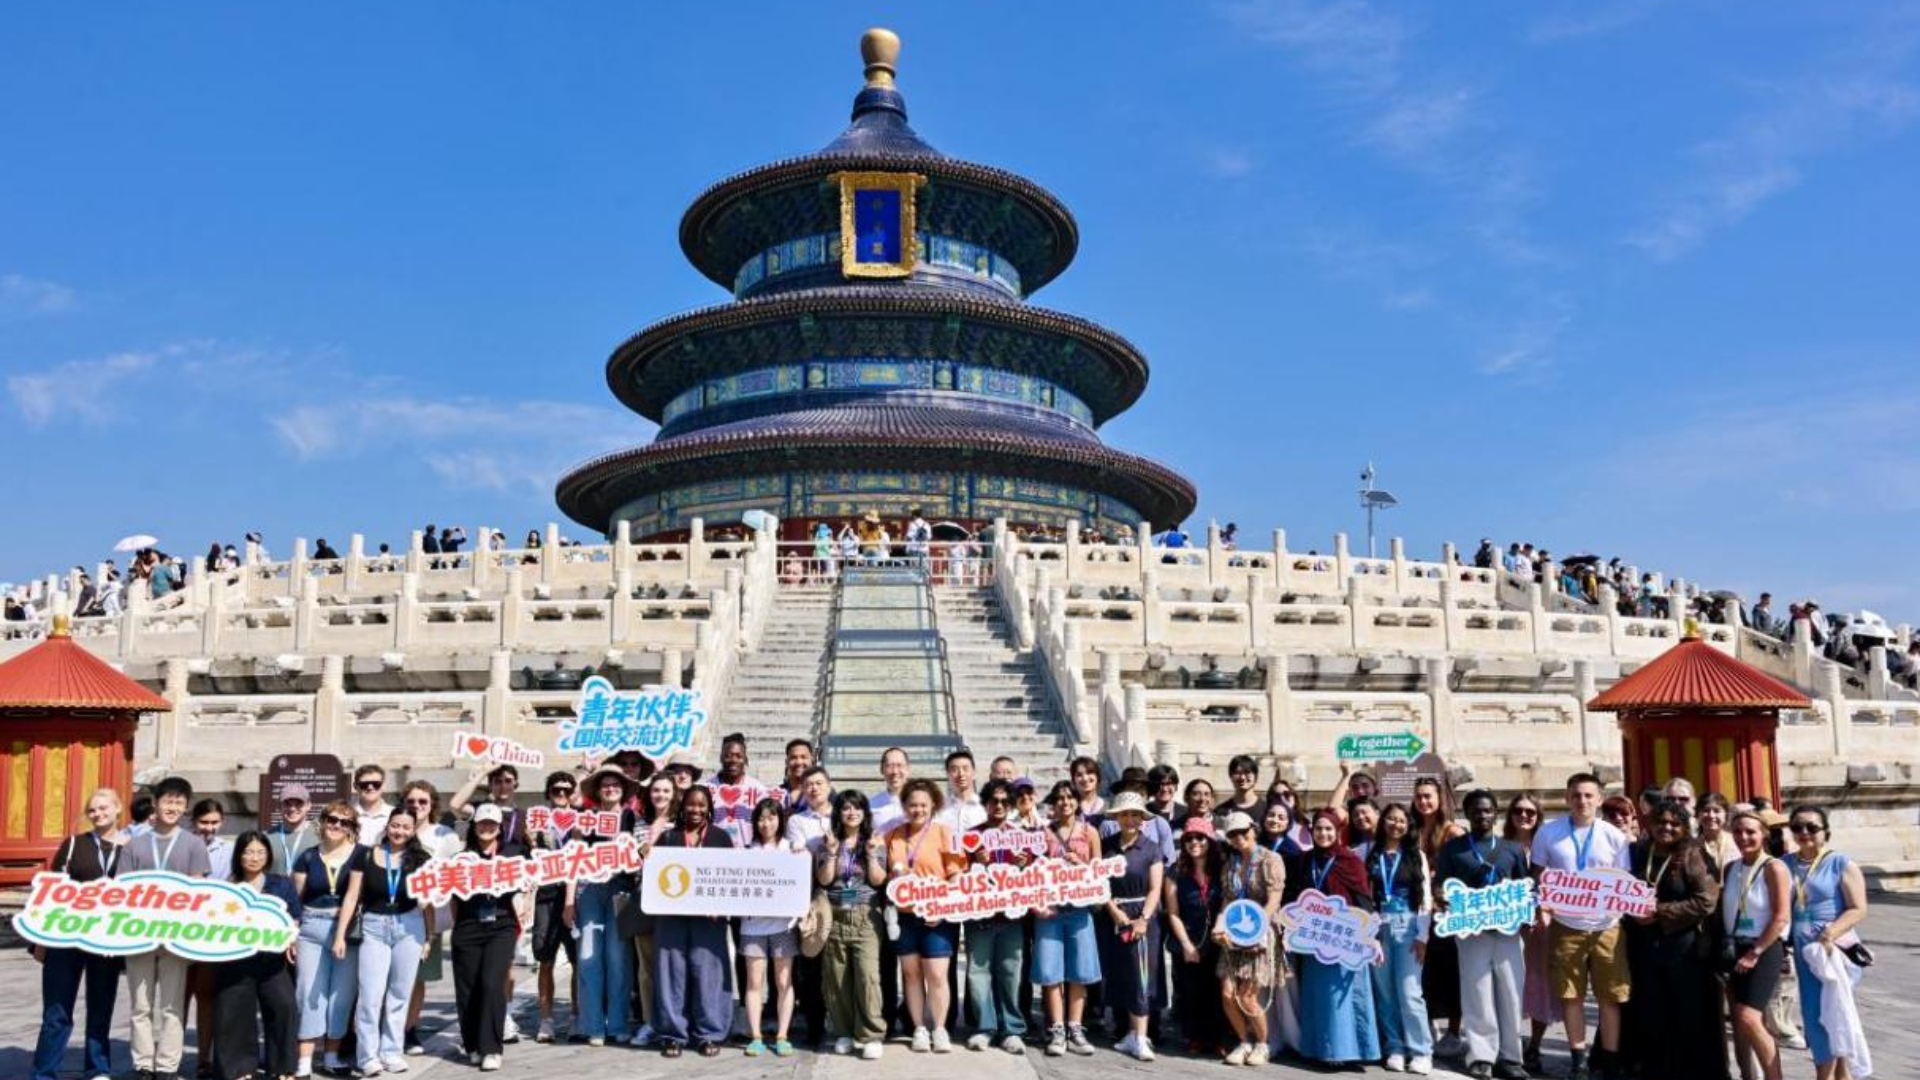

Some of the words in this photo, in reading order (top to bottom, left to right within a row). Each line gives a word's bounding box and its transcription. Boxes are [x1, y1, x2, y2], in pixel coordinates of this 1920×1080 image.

[582, 692, 692, 725] 青年伙伴
[456, 734, 463, 755] I
[490, 740, 541, 764] China
[573, 719, 693, 752] 国际交流计划
[1352, 736, 1411, 751] Together
[529, 809, 549, 829] 我
[578, 812, 619, 834] 中国
[984, 830, 1044, 850] Beijing
[410, 859, 522, 897] 中美青年
[541, 841, 642, 881] 亚太同心
[696, 867, 711, 876] NG
[716, 867, 743, 877] TENG
[746, 868, 775, 877] FONG
[993, 867, 1045, 891] Youth
[1092, 860, 1111, 876] for
[1114, 862, 1122, 874] a
[32, 877, 211, 912] Together
[926, 899, 973, 917] Shared
[976, 889, 1058, 909] Asia-Pacific
[1059, 884, 1104, 900] Future
[1305, 902, 1333, 916] 2026
[1448, 883, 1526, 914] 青年伙伴
[1541, 886, 1597, 908] Youth
[1604, 895, 1652, 914] Tour
[42, 907, 101, 935] for
[105, 911, 291, 948] Tomorrow
